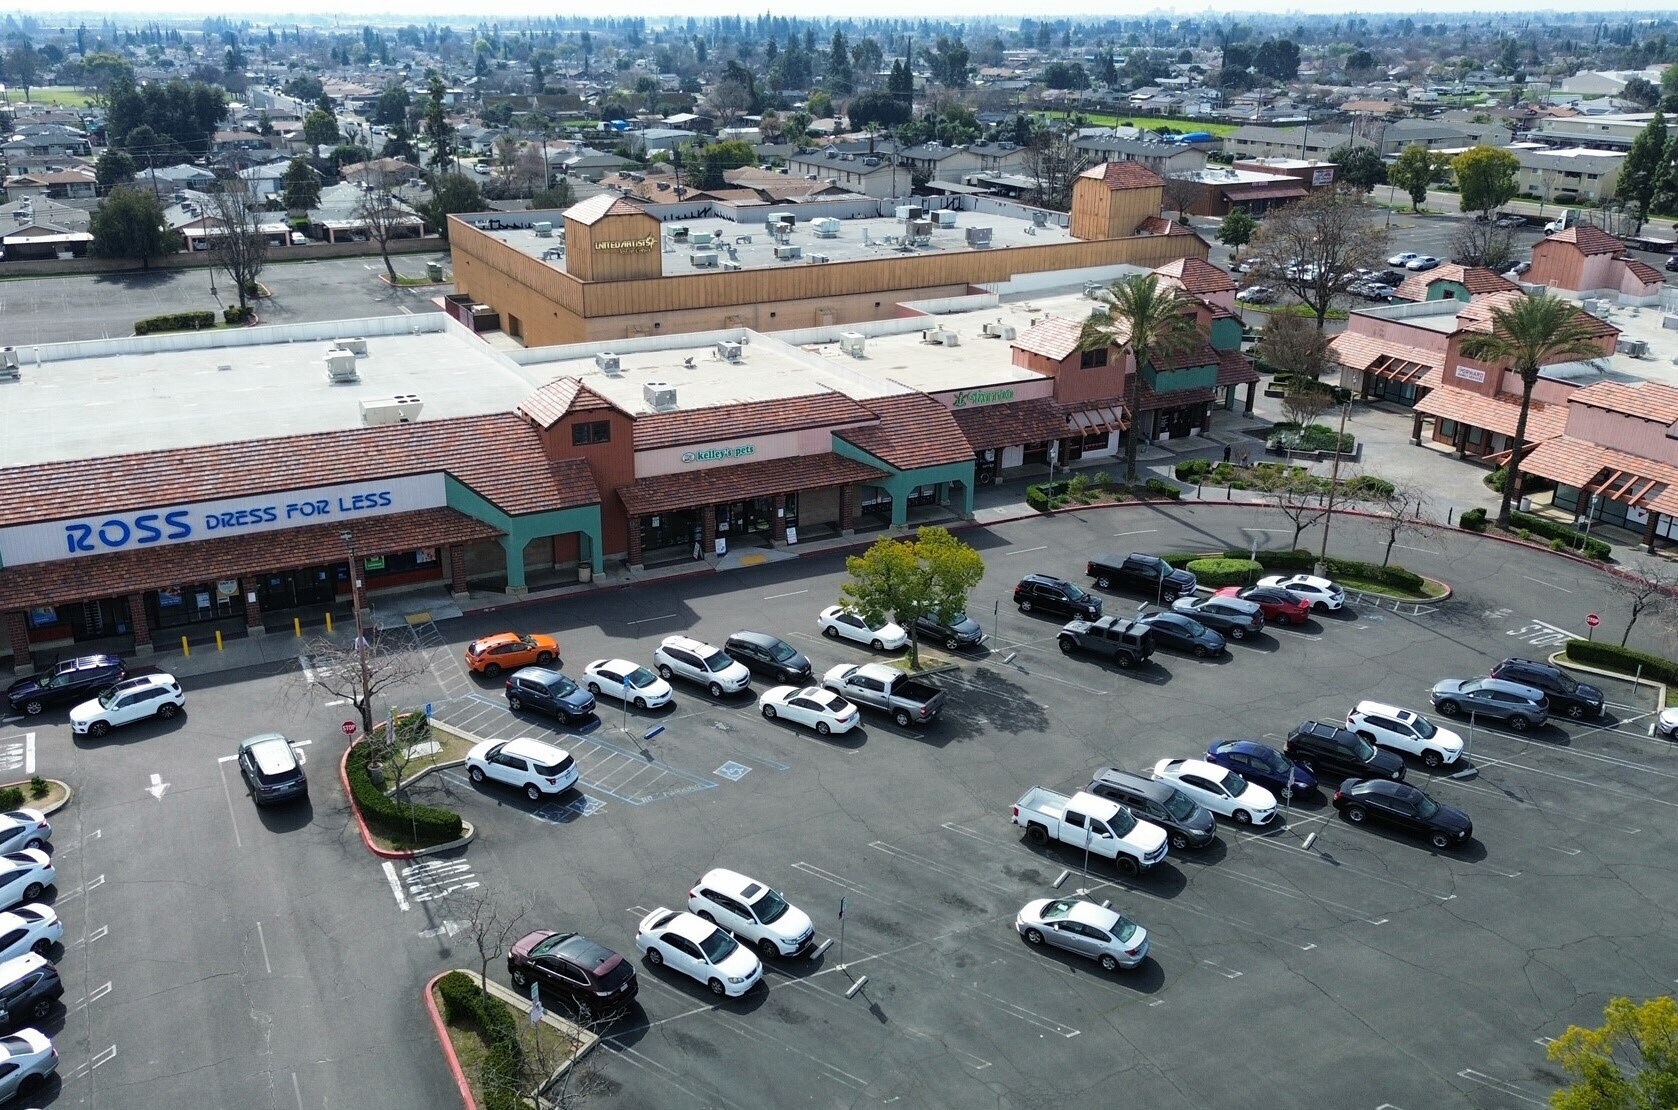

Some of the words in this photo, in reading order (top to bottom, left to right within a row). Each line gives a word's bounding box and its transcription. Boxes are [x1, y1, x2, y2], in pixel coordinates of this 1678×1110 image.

[595, 241, 621, 250] UNITED
[620, 240, 651, 248] ARTISTS
[697, 448, 732, 460] kelley's
[735, 445, 754, 457] pets
[65, 510, 192, 553] ROSS
[205, 506, 277, 531] DRESS
[286, 499, 331, 519] FOR
[338, 491, 393, 512] LESS
[342, 724, 356, 732] STOP
